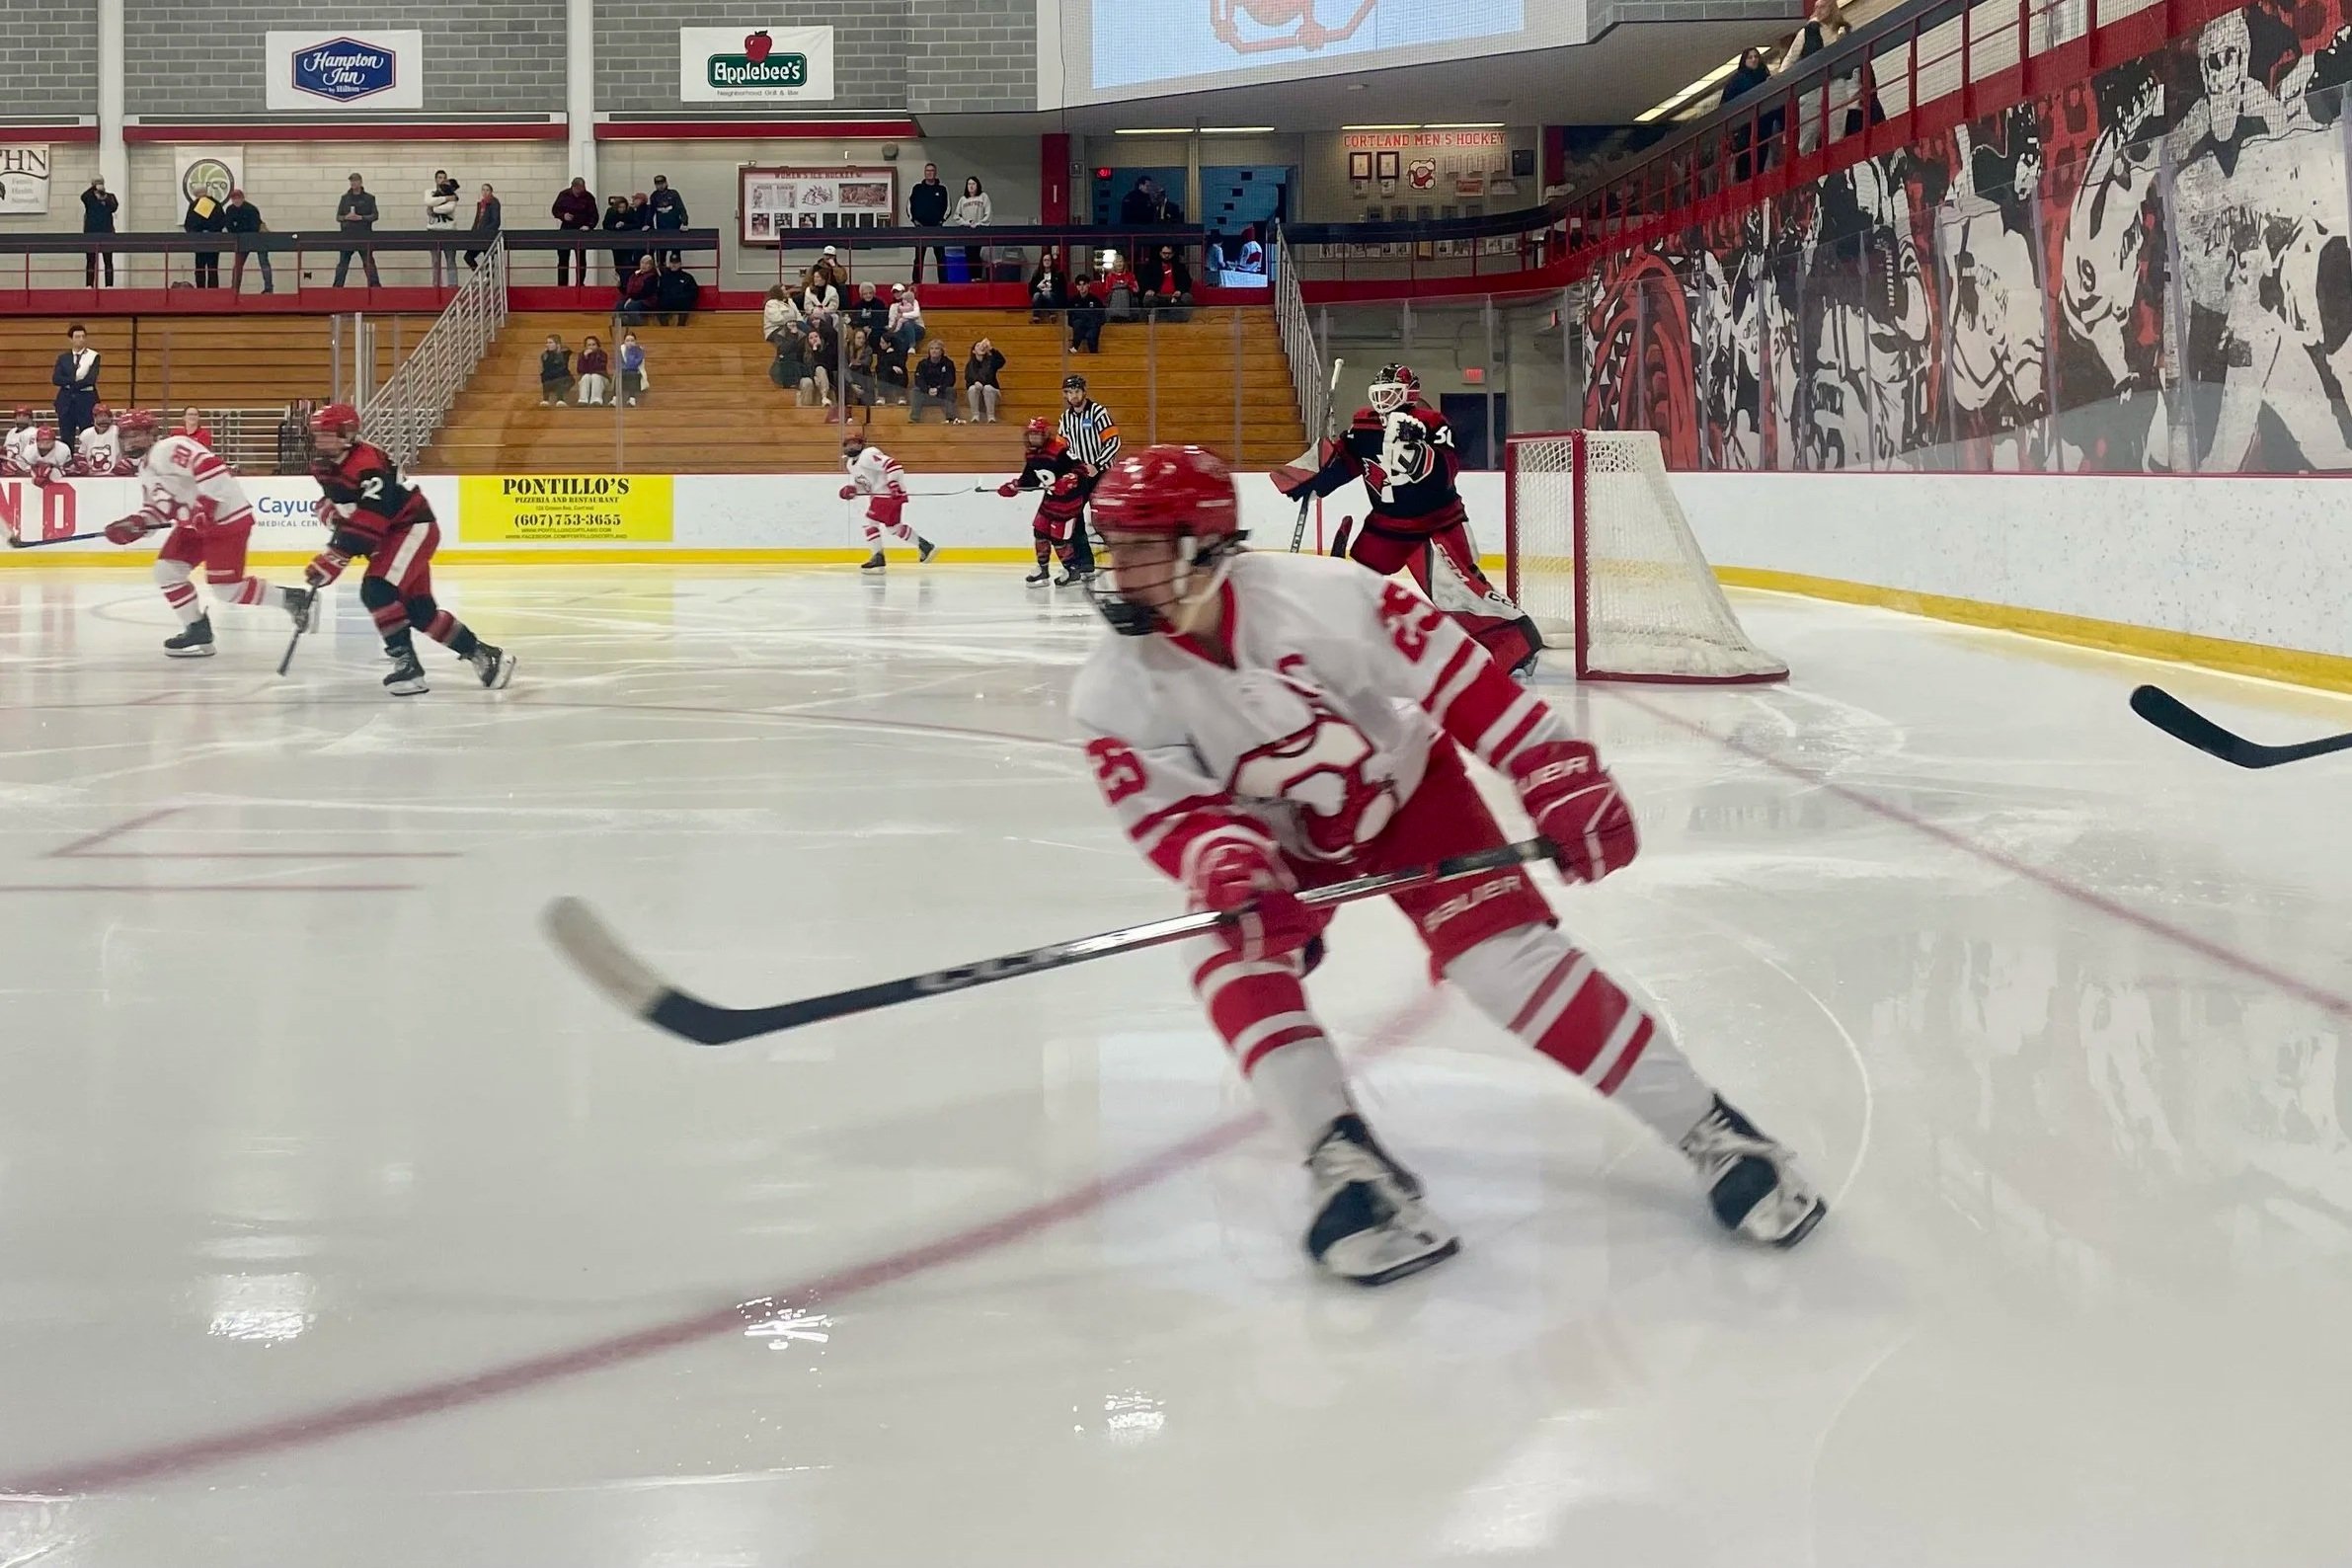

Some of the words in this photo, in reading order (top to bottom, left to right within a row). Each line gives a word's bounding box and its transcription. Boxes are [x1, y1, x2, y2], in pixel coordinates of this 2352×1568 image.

[303, 51, 384, 72] Hampton
[322, 67, 365, 86] Inn
[714, 61, 801, 84] Applebee's
[1344, 134, 1410, 147] CORTLAND
[1456, 132, 1506, 145] HOCKEY
[0, 149, 47, 171] HN
[504, 478, 630, 495] PONTILLO'S
[258, 497, 319, 517] Cayug
[1488, 591, 1518, 609] CC
[1086, 737, 1146, 805] 23
[1422, 875, 1522, 933] BAUER
